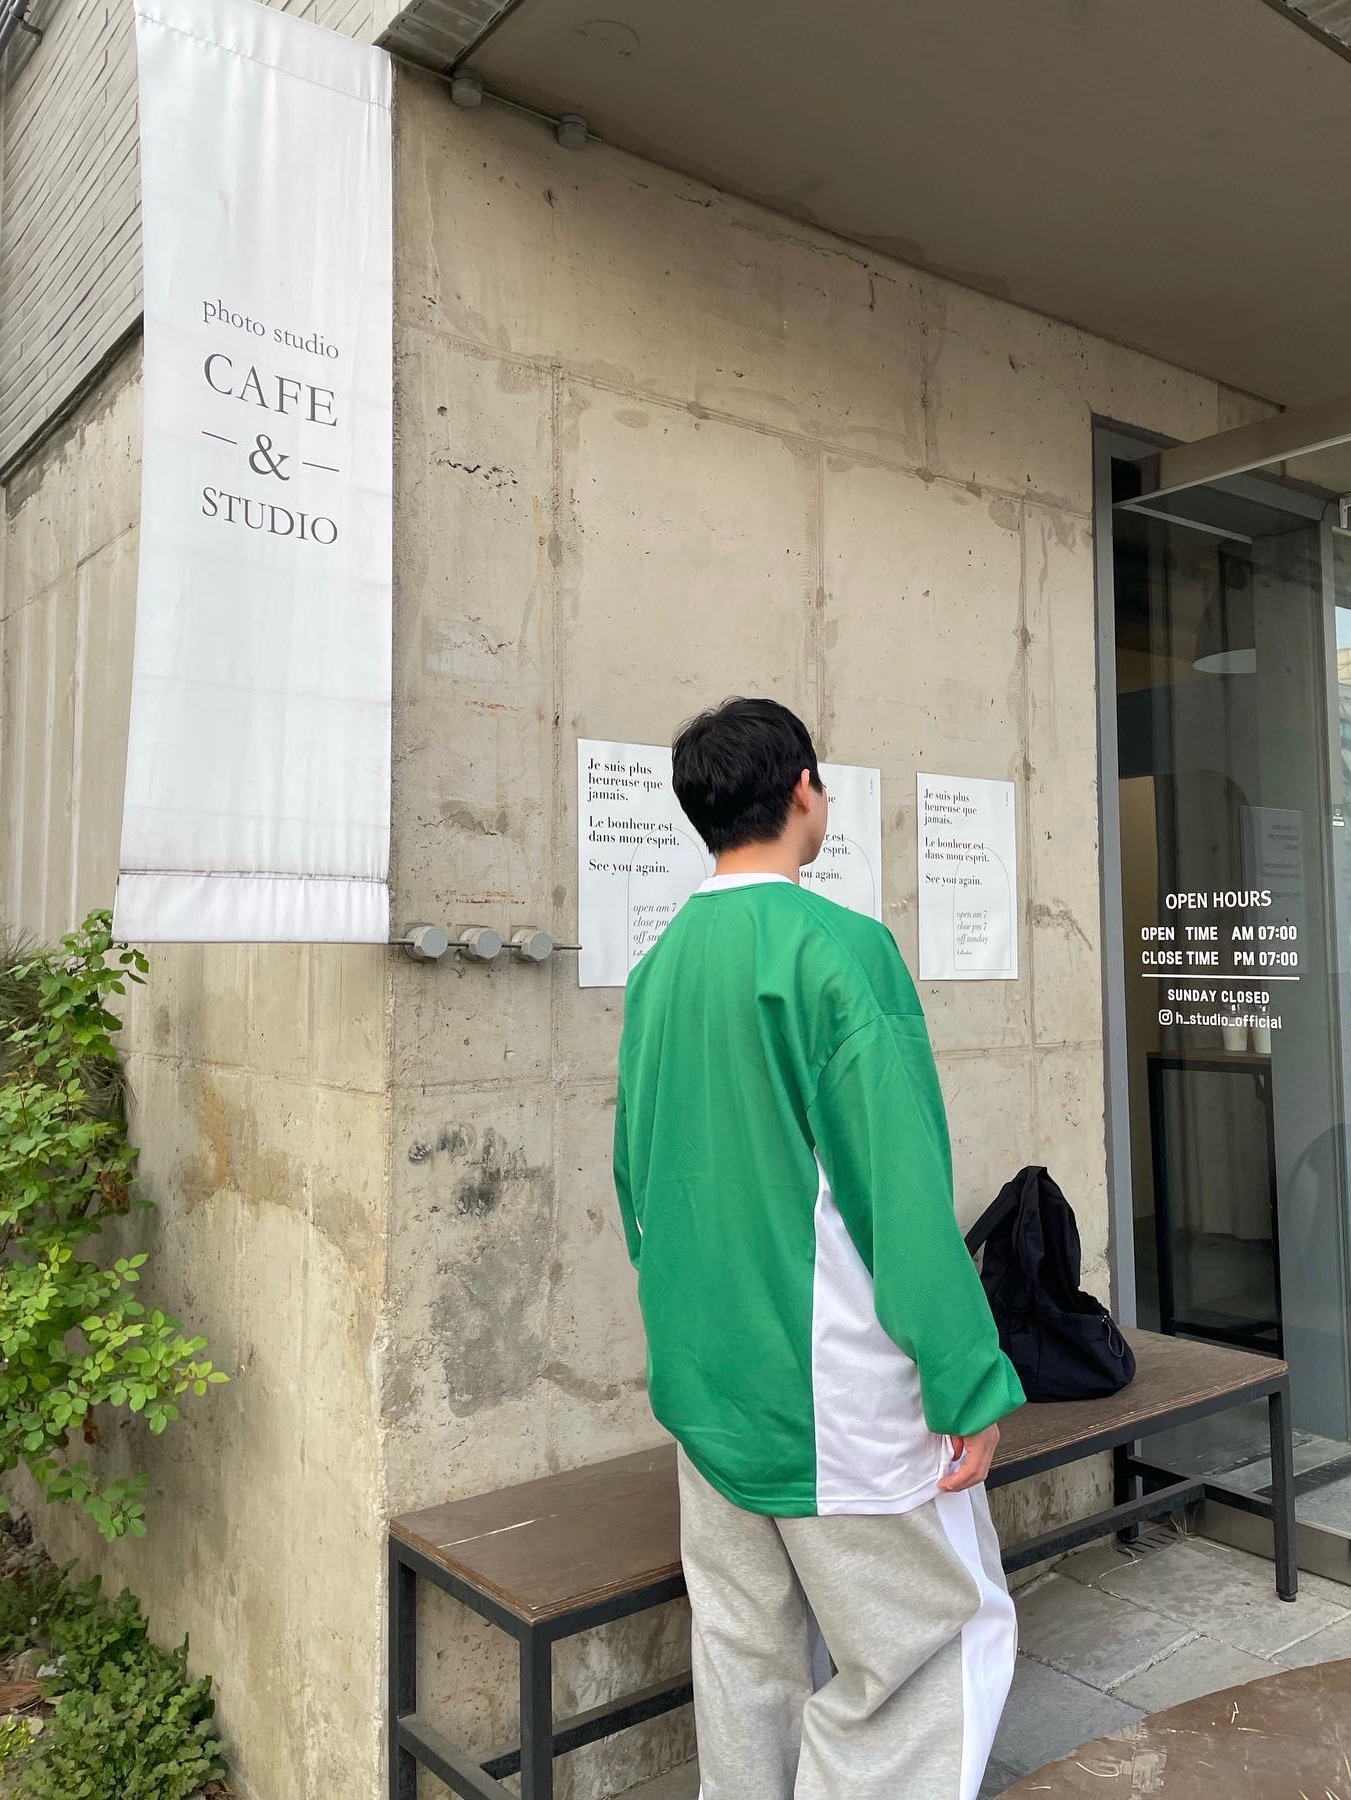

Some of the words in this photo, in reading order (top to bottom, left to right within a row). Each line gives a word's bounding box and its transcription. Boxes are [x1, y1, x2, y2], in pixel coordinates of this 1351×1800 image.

[202, 299, 266, 336] photo
[273, 327, 340, 359] studio
[203, 353, 338, 427] CAFE
[249, 434, 291, 481] &
[202, 486, 339, 545] STUDIO
[587, 757, 601, 771] Je
[603, 760, 627, 774] suis
[629, 762, 653, 776] plus
[588, 772, 641, 789] heureuse
[643, 779, 663, 792] que
[587, 787, 628, 802] jamais.
[924, 788, 933, 799] Je
[935, 790, 952, 802] suis
[953, 792, 970, 804] plus
[924, 801, 961, 814] heureuse
[962, 806, 977, 816] que
[588, 814, 605, 829] Le
[607, 816, 657, 832] bonheur
[657, 823, 674, 833] est
[923, 813, 953, 826] jamais.
[588, 830, 617, 844] dans
[619, 834, 644, 845] mon
[646, 834, 681, 849] esprit.
[831, 833, 845, 843] est
[925, 836, 936, 849] Le
[937, 839, 972, 850] bonheur
[973, 840, 986, 850] est
[823, 845, 851, 856] esprit.
[924, 849, 945, 861] dans
[946, 852, 964, 862] mon
[965, 851, 990, 864] esprit.
[588, 858, 609, 873] See
[611, 862, 634, 876] you
[635, 862, 670, 876] again.
[800, 870, 813, 880] ou
[815, 869, 842, 882] again.
[925, 872, 941, 884] See
[941, 875, 957, 888] you
[958, 874, 983, 887] again.
[1165, 892, 1208, 910] OPEN
[1212, 889, 1272, 908] HOURS
[632, 904, 654, 915] open
[655, 904, 670, 913] am
[671, 902, 678, 913] 7
[632, 916, 654, 928] close
[632, 930, 649, 945] off
[1141, 926, 1175, 941] OPEN
[1184, 926, 1219, 941] TIME
[1231, 926, 1254, 941] AM
[1258, 925, 1298, 941] 07:00
[1141, 950, 1183, 965] CLOSE
[1186, 951, 1219, 966] TIME
[1233, 951, 1255, 966] PM
[1259, 951, 1299, 967] 07:00
[1167, 988, 1218, 1002] SUNDAY
[1221, 990, 1270, 1004] CLOSED
[1175, 1011, 1282, 1029] h_studio_official
